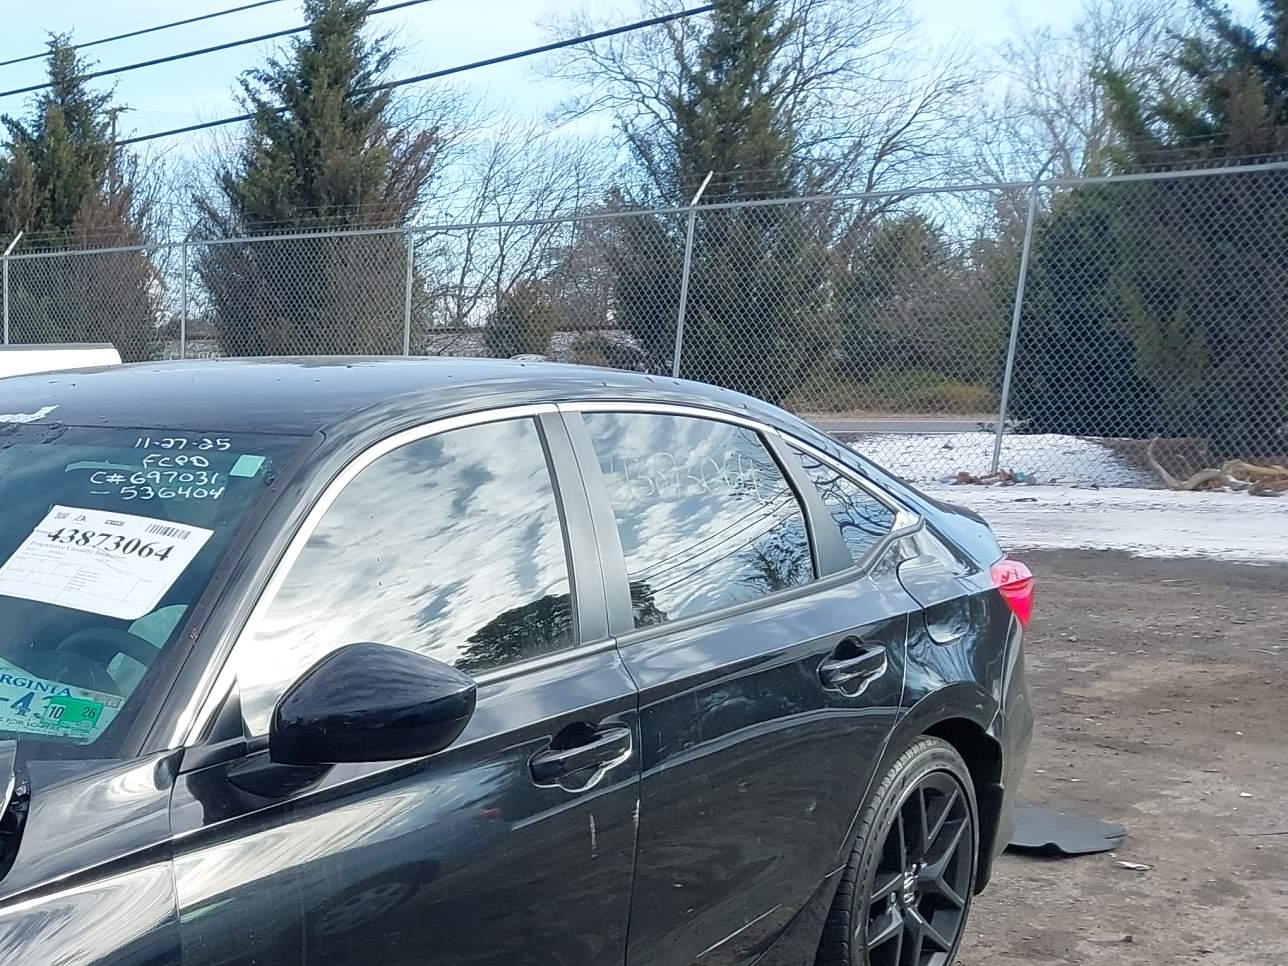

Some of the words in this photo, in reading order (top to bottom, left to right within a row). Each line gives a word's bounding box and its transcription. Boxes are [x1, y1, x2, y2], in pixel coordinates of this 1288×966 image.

[134, 437, 232, 451] 11-27-25
[47, 527, 175, 562] 43873064
[48, 704, 65, 720] 10
[81, 706, 98, 718] 26
[6, 716, 24, 726] FOR
